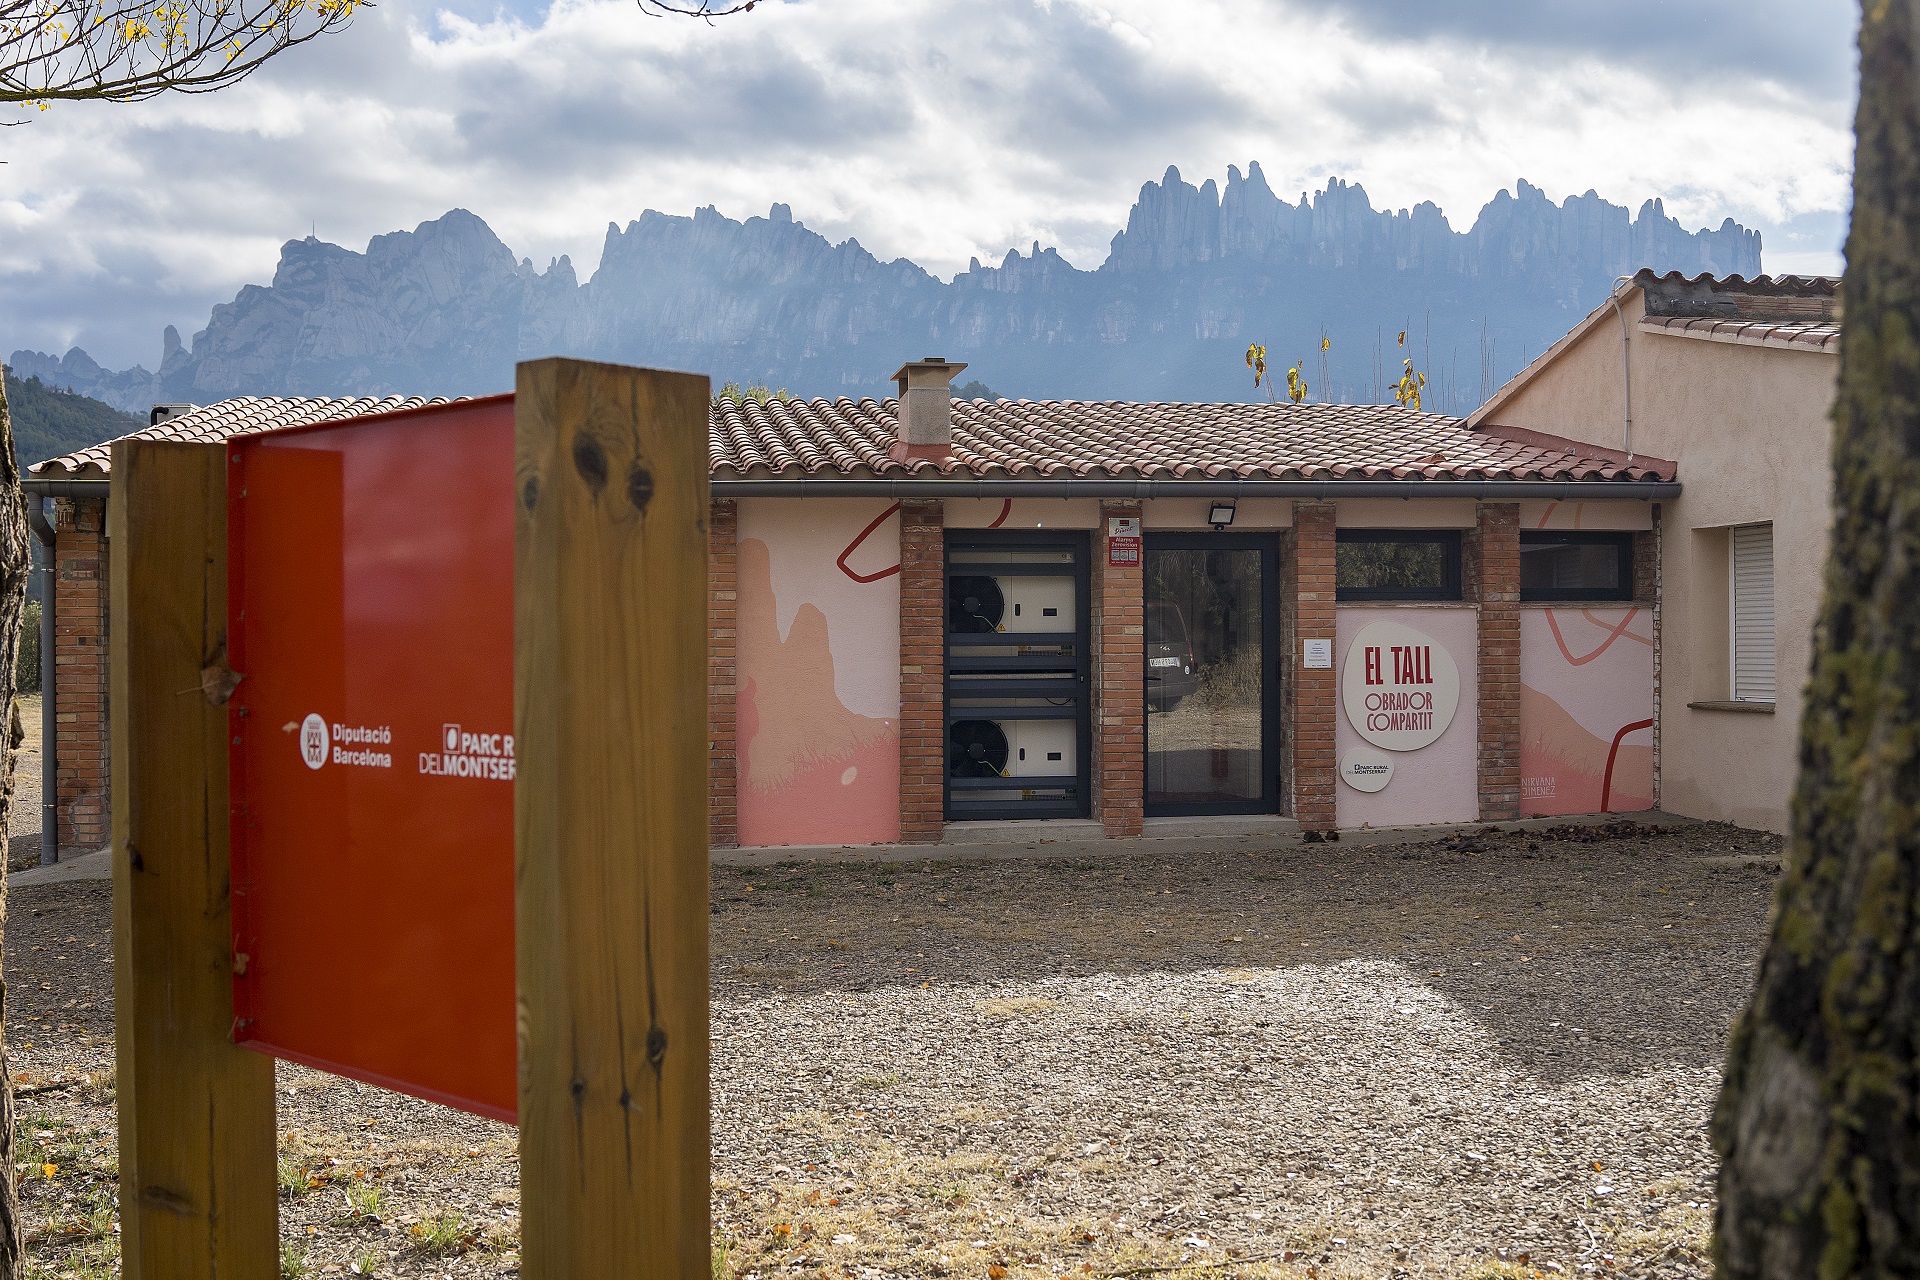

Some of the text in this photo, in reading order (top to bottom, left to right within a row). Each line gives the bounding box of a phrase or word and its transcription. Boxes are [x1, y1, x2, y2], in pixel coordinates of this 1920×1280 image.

[1364, 646, 1384, 686] EL
[1390, 645, 1434, 685] TALL
[1364, 692, 1434, 712] OBRADOR
[1366, 712, 1434, 732] COMPARTIT
[332, 723, 392, 746] Diputació
[461, 732, 501, 755] PARC
[332, 746, 392, 768] Barcelona
[1521, 777, 1556, 787] NIRVANA
[1521, 786, 1556, 797] JIMENEZ
